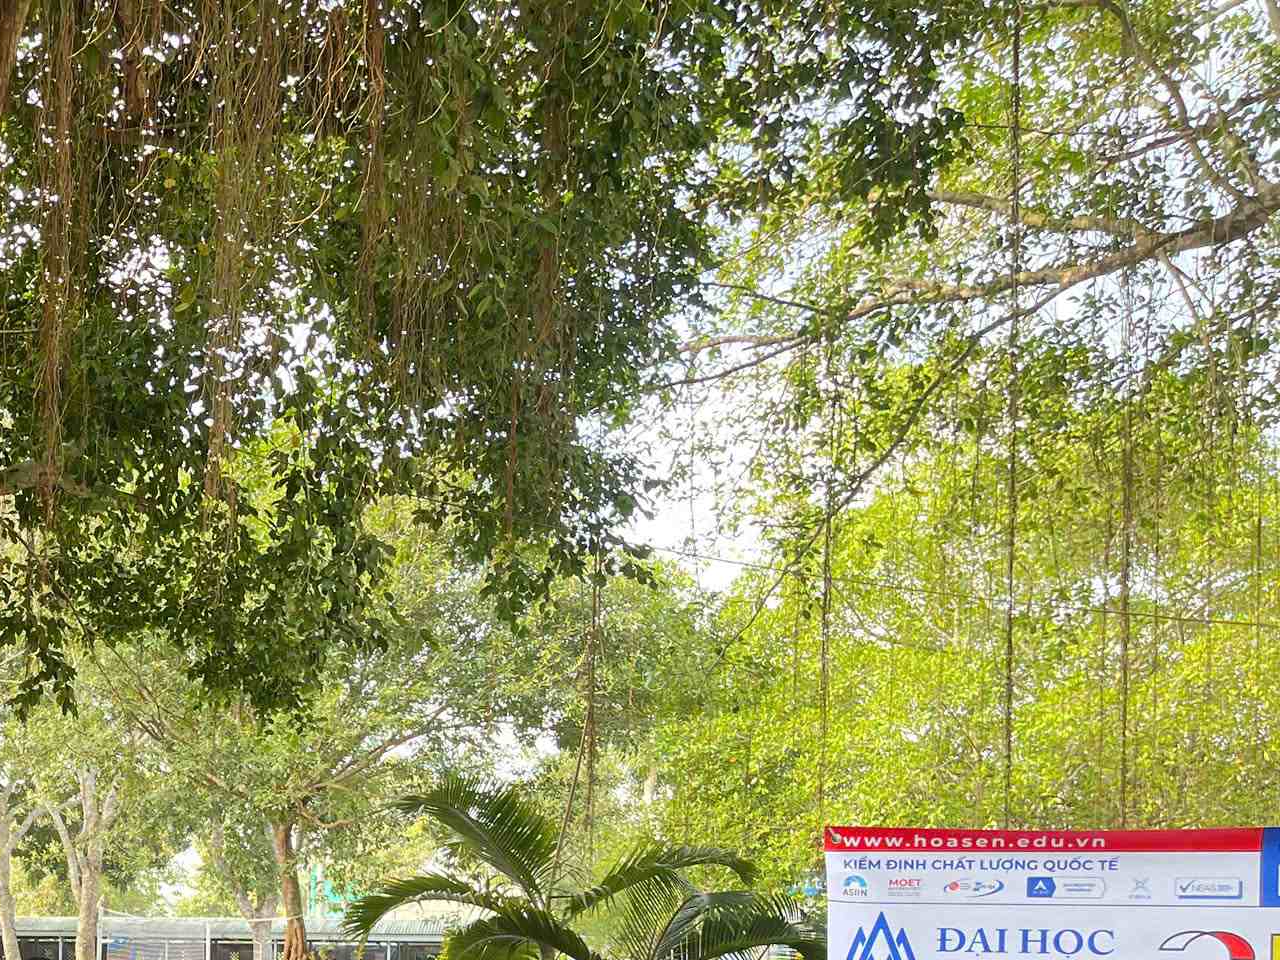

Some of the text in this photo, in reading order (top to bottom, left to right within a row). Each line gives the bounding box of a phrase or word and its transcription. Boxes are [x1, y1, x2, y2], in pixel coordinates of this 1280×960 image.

[843, 834, 1106, 848] www.hoasen.edu.vn
[843, 856, 1120, 874] KIỂM ĐỊNH CHẤT LƯỢNG QUỐC TẾ
[888, 879, 921, 888] MOET
[936, 927, 1115, 959] ĐẠI HỌC
